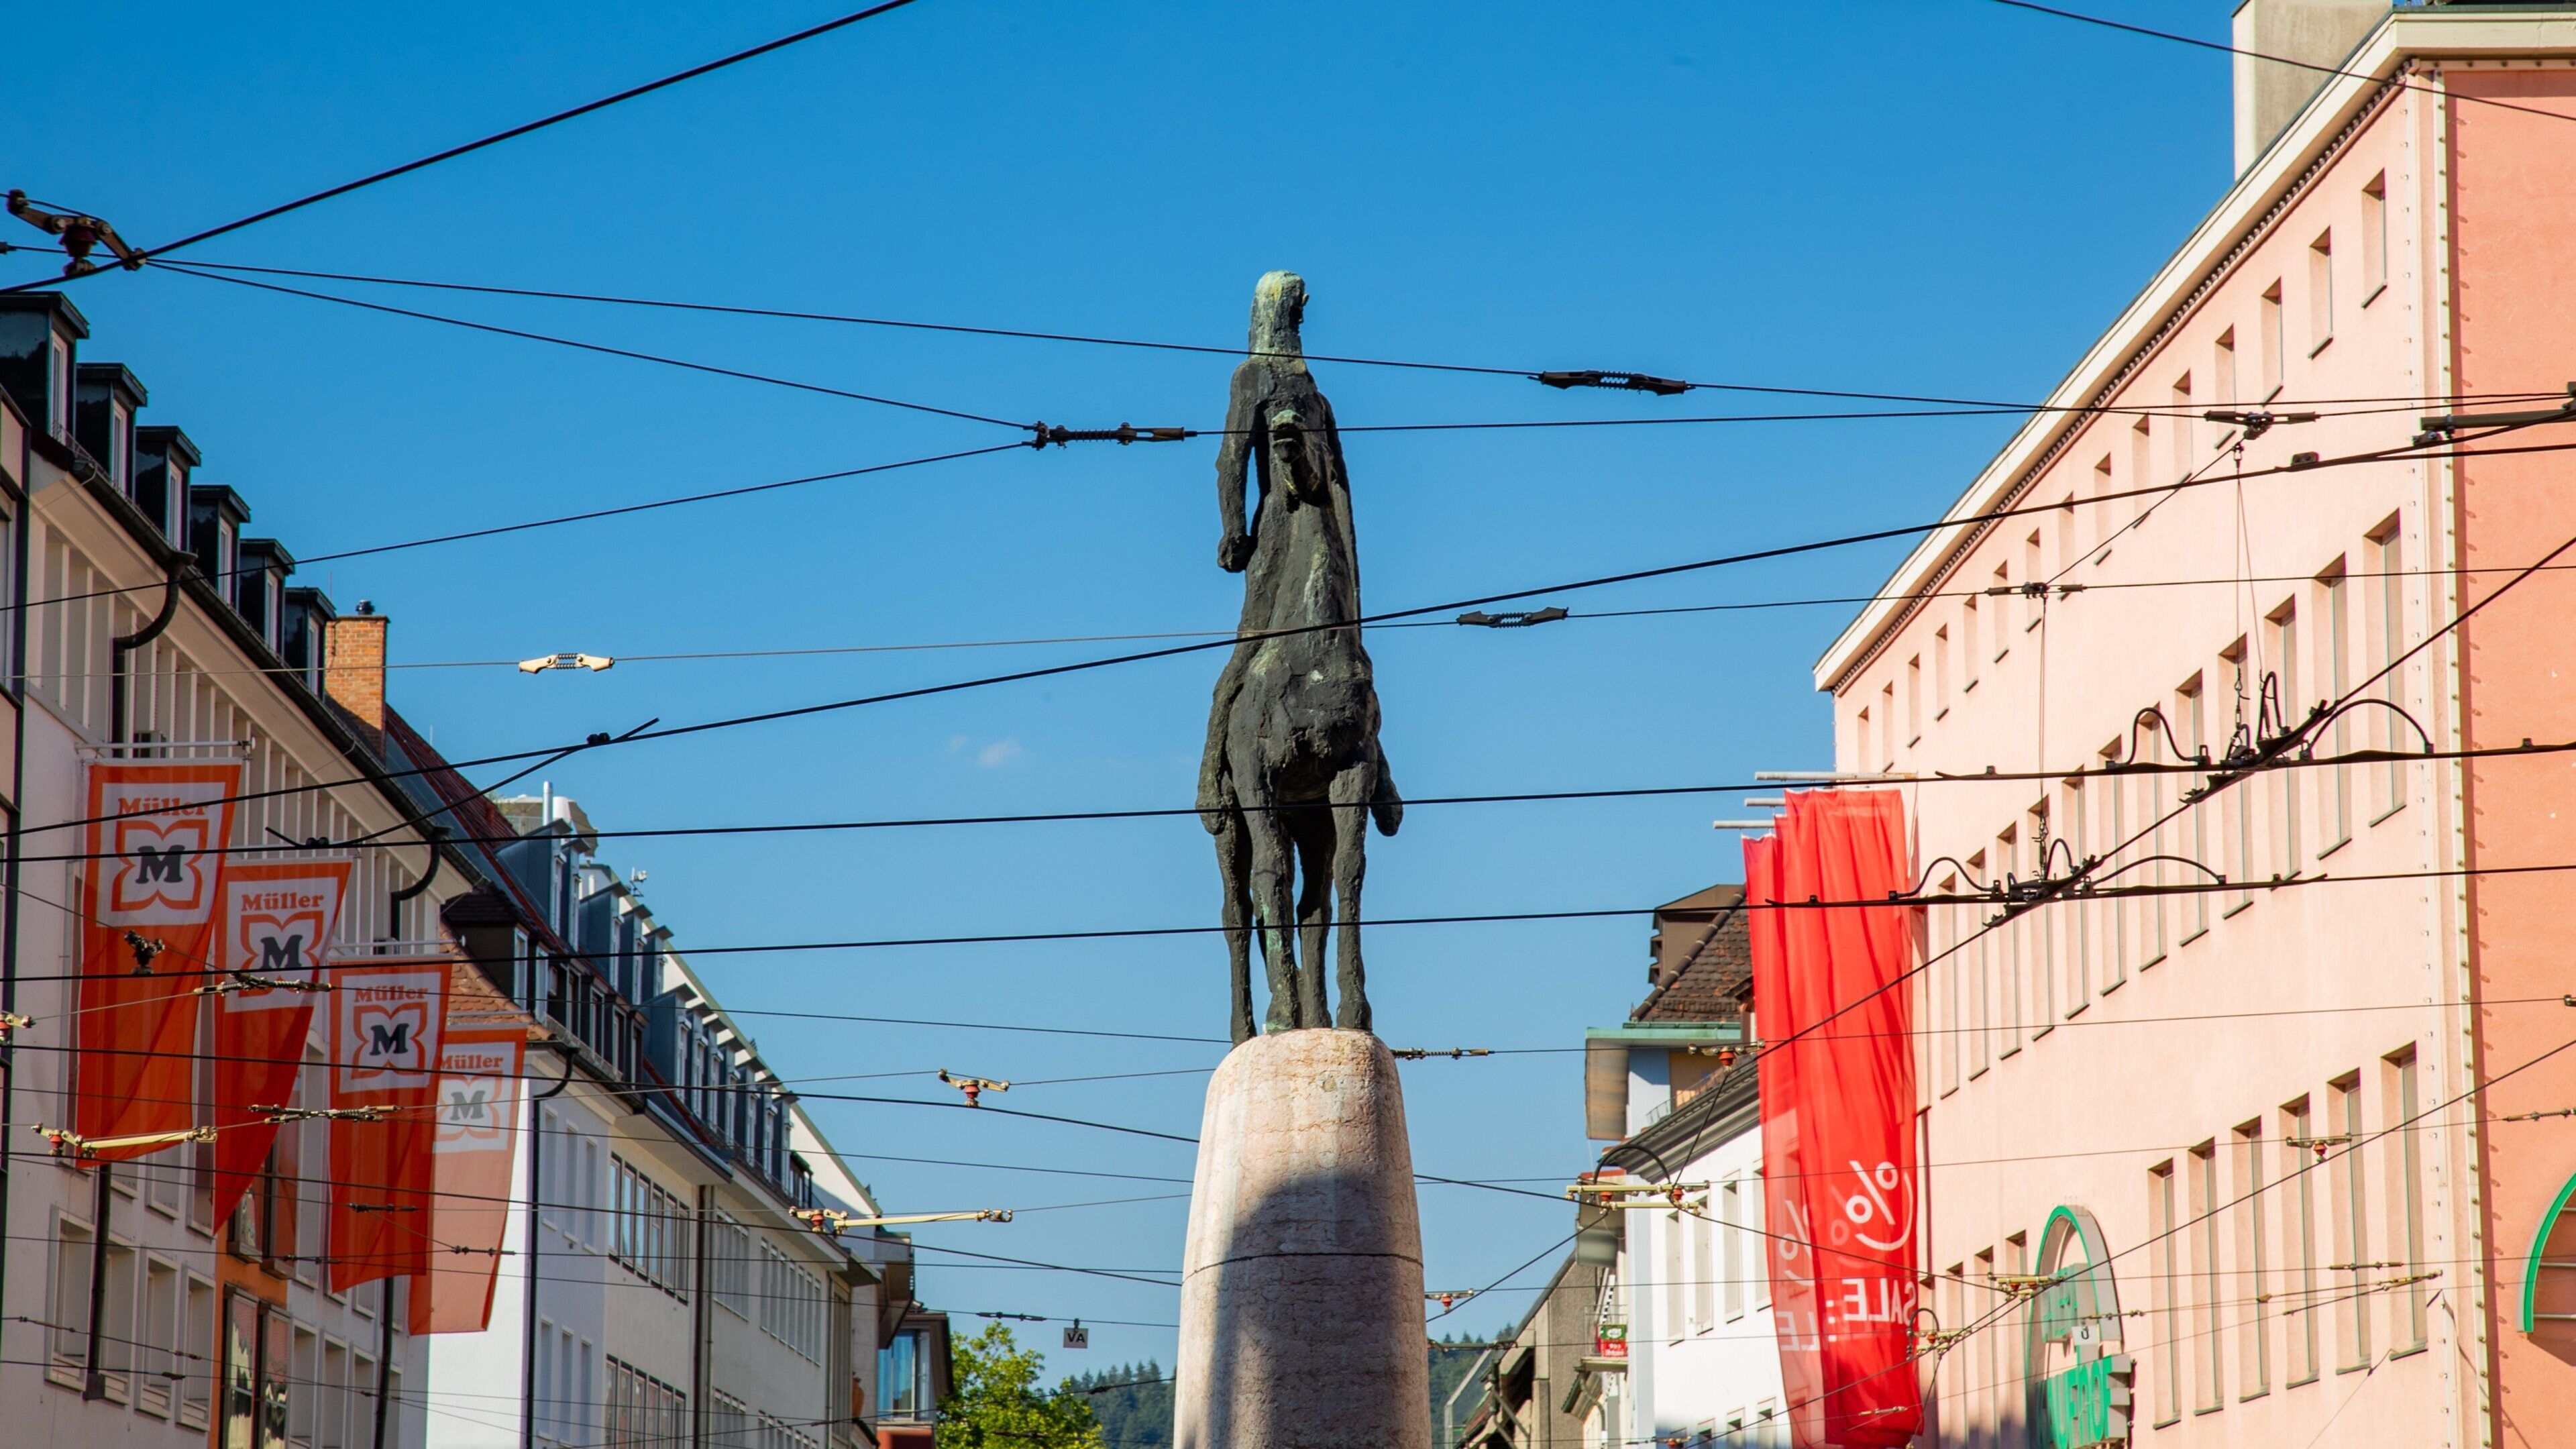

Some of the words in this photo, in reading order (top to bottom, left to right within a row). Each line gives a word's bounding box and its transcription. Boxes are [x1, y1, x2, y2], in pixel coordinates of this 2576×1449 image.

[118, 797, 210, 816] Müller
[136, 845, 185, 884] M
[241, 892, 325, 911] Müller
[260, 934, 303, 969] M
[354, 985, 429, 1002] Müller
[370, 1023, 409, 1056] M
[439, 1055, 504, 1069] Müller
[449, 1090, 486, 1121] M
[1067, 1332, 1085, 1342] VA
